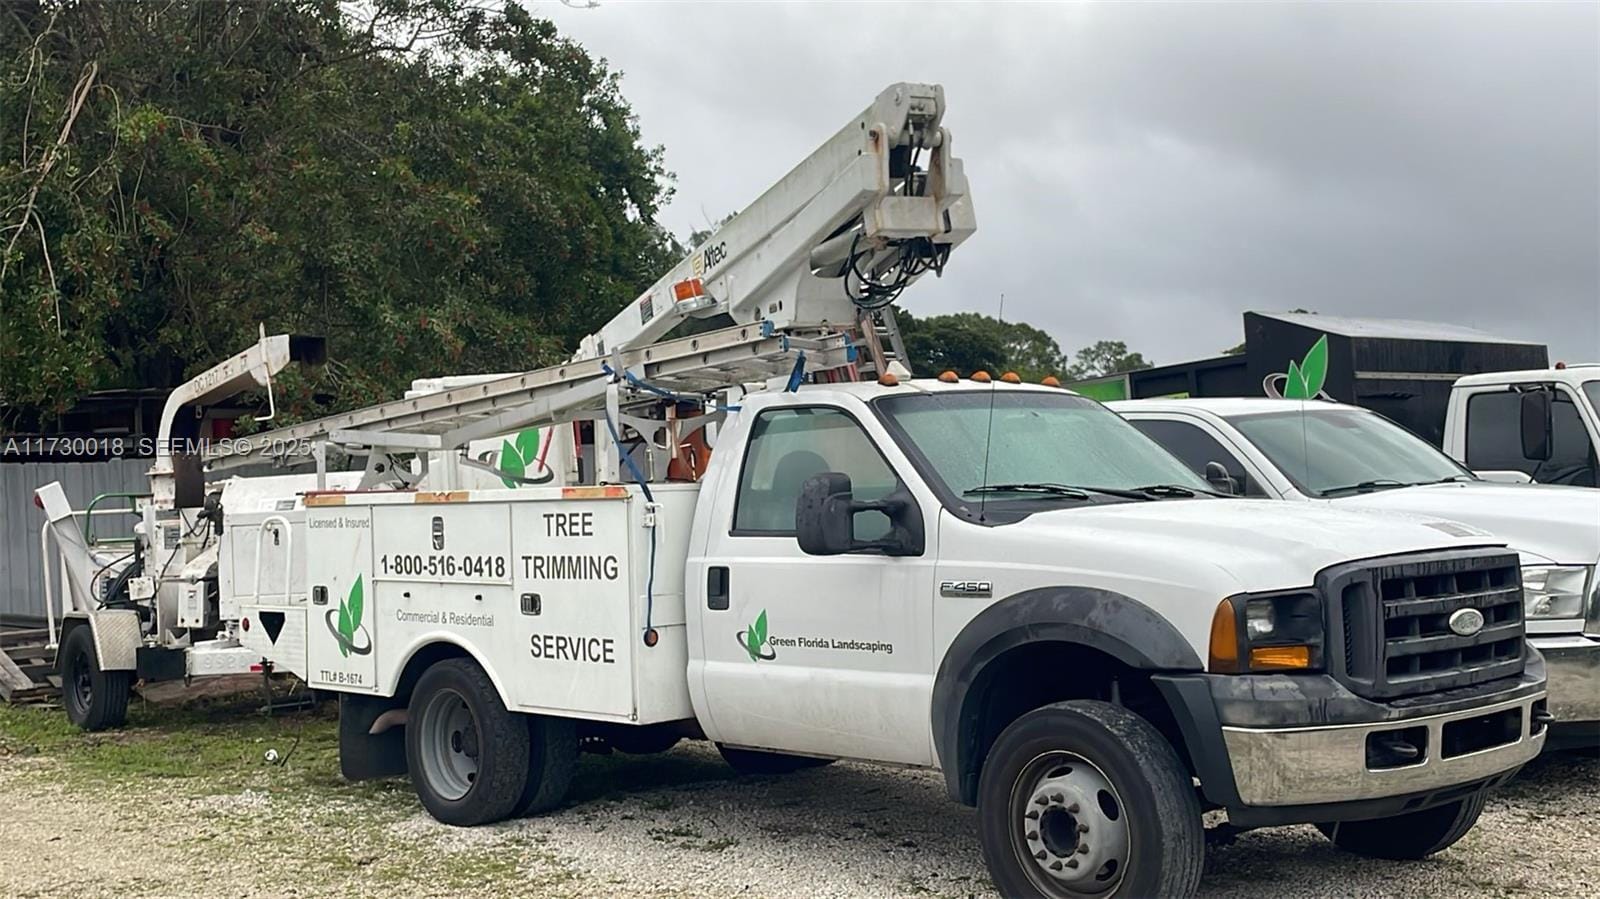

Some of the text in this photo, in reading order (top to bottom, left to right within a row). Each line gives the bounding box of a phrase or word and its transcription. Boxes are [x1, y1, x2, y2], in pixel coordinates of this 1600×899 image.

[703, 241, 727, 274] Altec
[309, 517, 370, 529] Licensed & Insured
[543, 512, 593, 537] TREE
[381, 554, 506, 578] 1-800-516-0418
[521, 555, 619, 580] TRIMMING
[396, 609, 495, 627] Commercial & Residential
[530, 634, 616, 664] SERVICE
[769, 636, 893, 654] Green Florida Landscaping
[320, 670, 338, 682] TTL#
